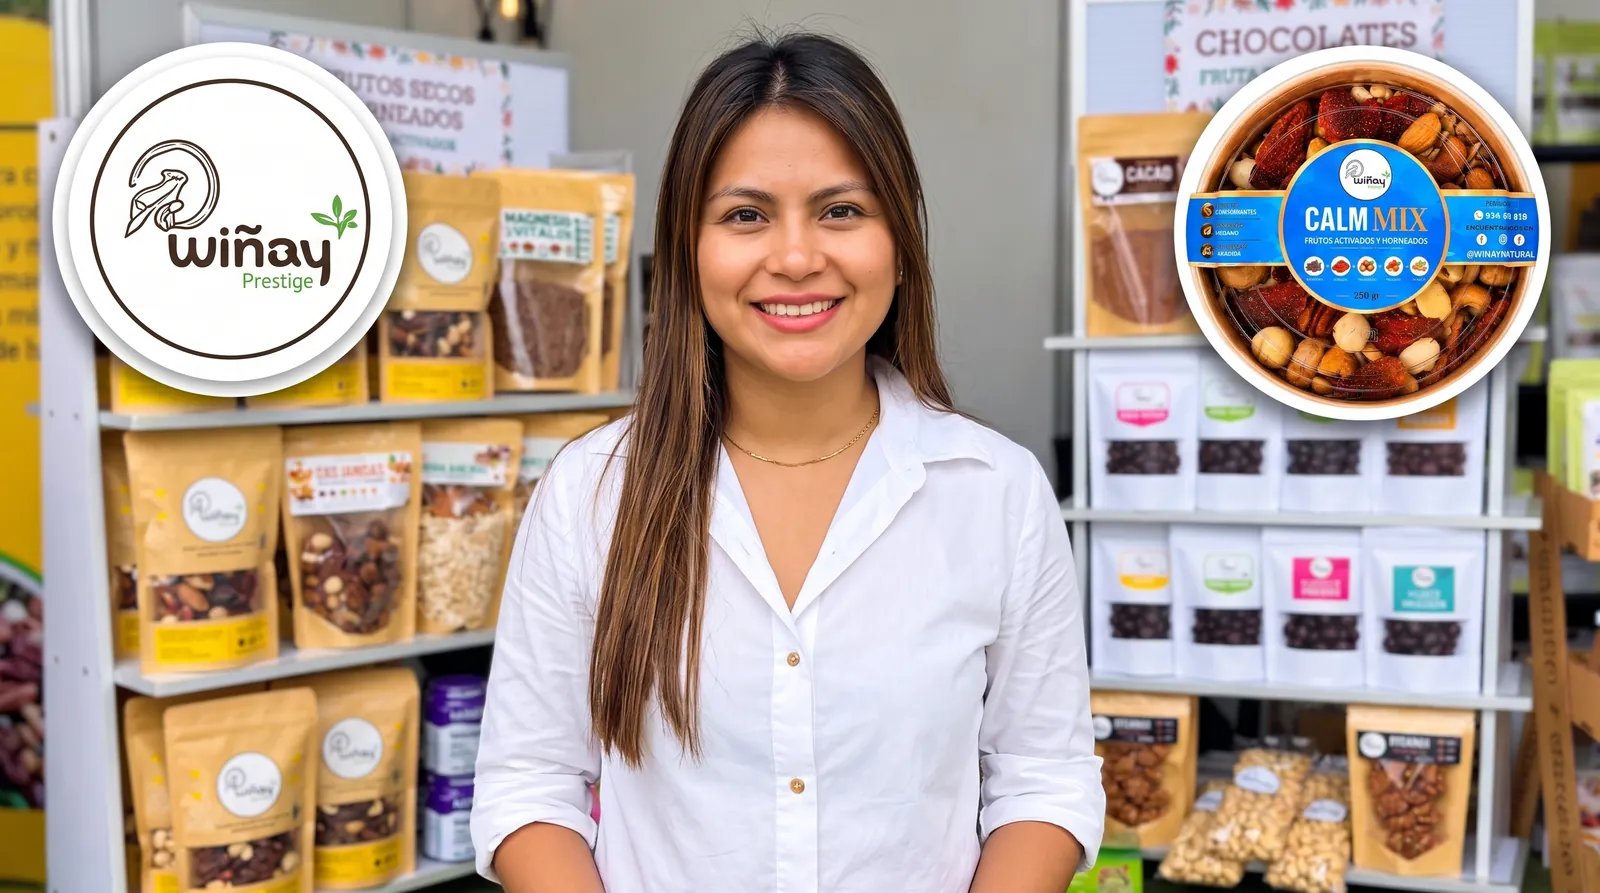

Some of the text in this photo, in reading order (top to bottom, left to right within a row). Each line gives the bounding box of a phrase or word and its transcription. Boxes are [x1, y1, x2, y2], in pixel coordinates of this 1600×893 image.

[1195, 22, 1418, 57] CHOCOLATES
[333, 69, 476, 106] RUTOS SECOS
[1304, 206, 1429, 232] CALM MIX
[1334, 237, 1375, 245] ACTIVADOS
[1375, 237, 1381, 245] Y
[1382, 237, 1429, 245] HORNEADOS
[1354, 291, 1370, 300] 250
